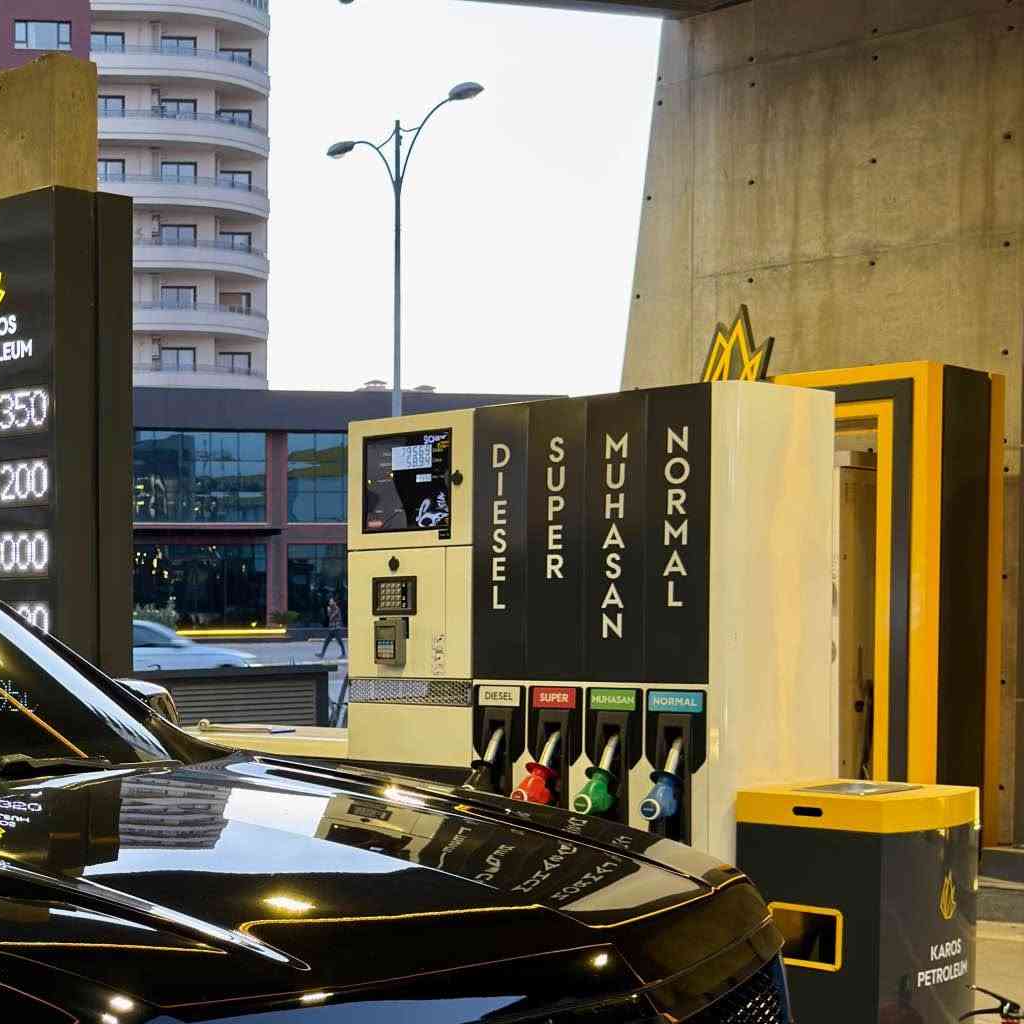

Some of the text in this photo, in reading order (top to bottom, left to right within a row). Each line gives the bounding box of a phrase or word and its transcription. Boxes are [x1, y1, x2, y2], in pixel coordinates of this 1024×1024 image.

[546, 436, 566, 579] SUPER
[663, 426, 690, 607] NORMAL
[492, 443, 510, 610] DIESEL
[601, 432, 628, 639] MUHASAN
[484, 690, 513, 700] DIESEL
[539, 692, 569, 703] SUPER
[592, 695, 636, 704] MUHASAN
[653, 697, 697, 707] NORMAL
[930, 938, 962, 961] KAROS
[917, 959, 968, 988] PETROLEUM
